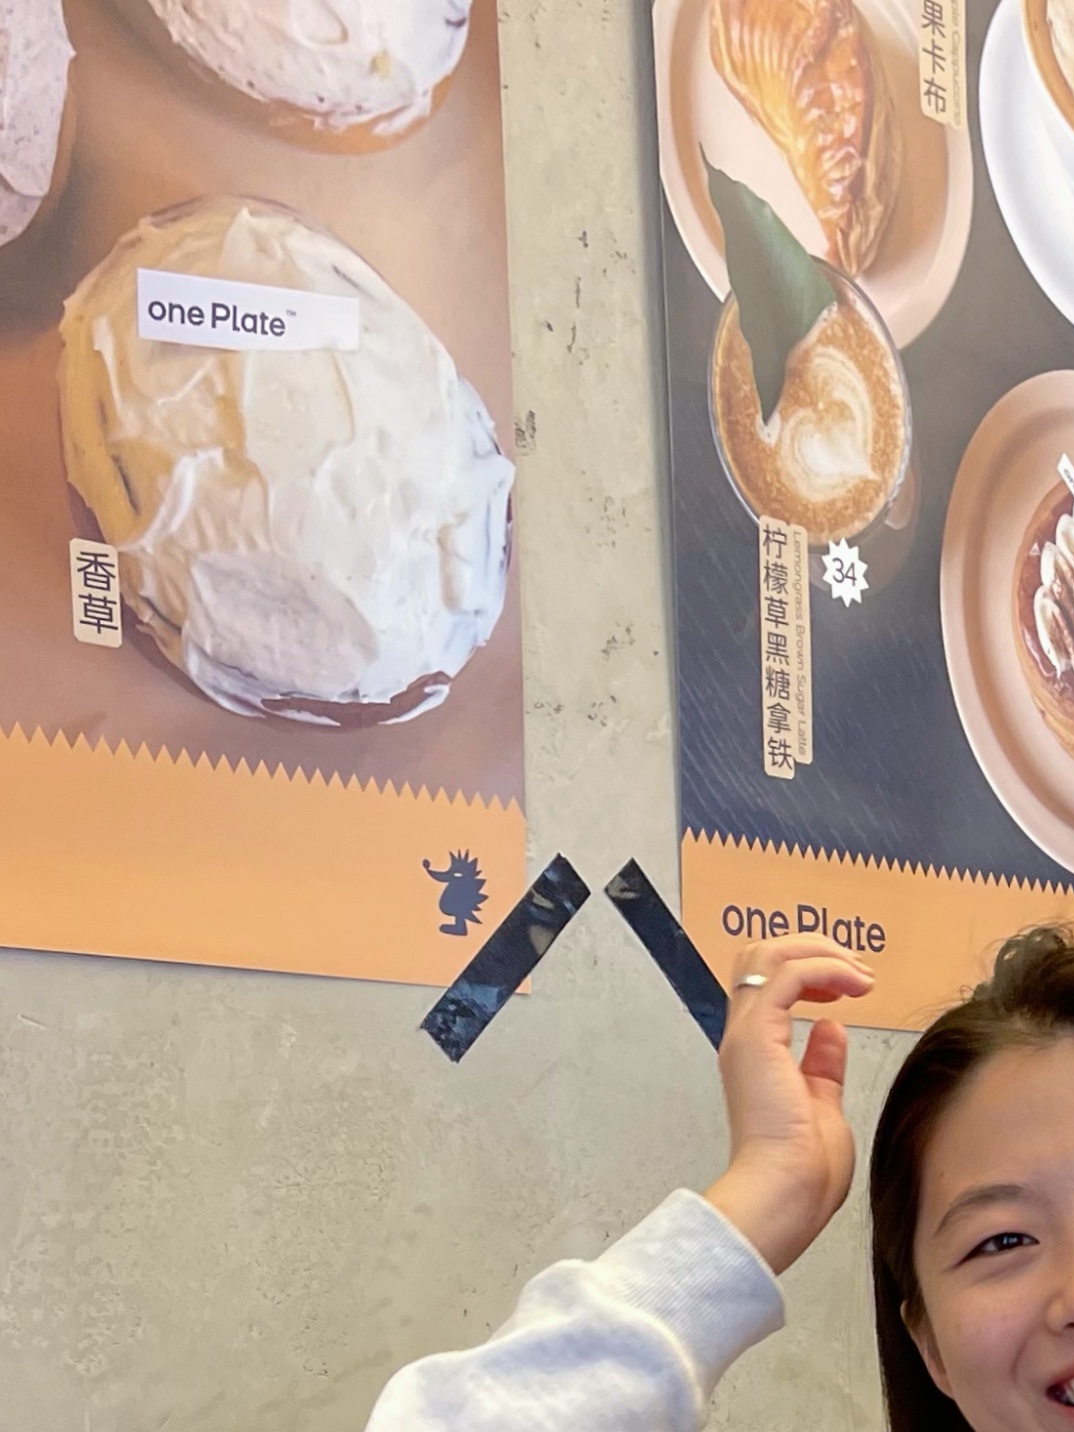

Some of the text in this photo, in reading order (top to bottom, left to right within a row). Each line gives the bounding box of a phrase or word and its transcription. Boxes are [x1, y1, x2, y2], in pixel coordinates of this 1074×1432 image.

[148, 300, 205, 326] one
[76, 551, 119, 635] 香草
[832, 557, 857, 587] 34
[763, 523, 793, 770] 柠檬草黑糖拿铁
[796, 625, 806, 671] Brown
[722, 904, 886, 953] one Plate
